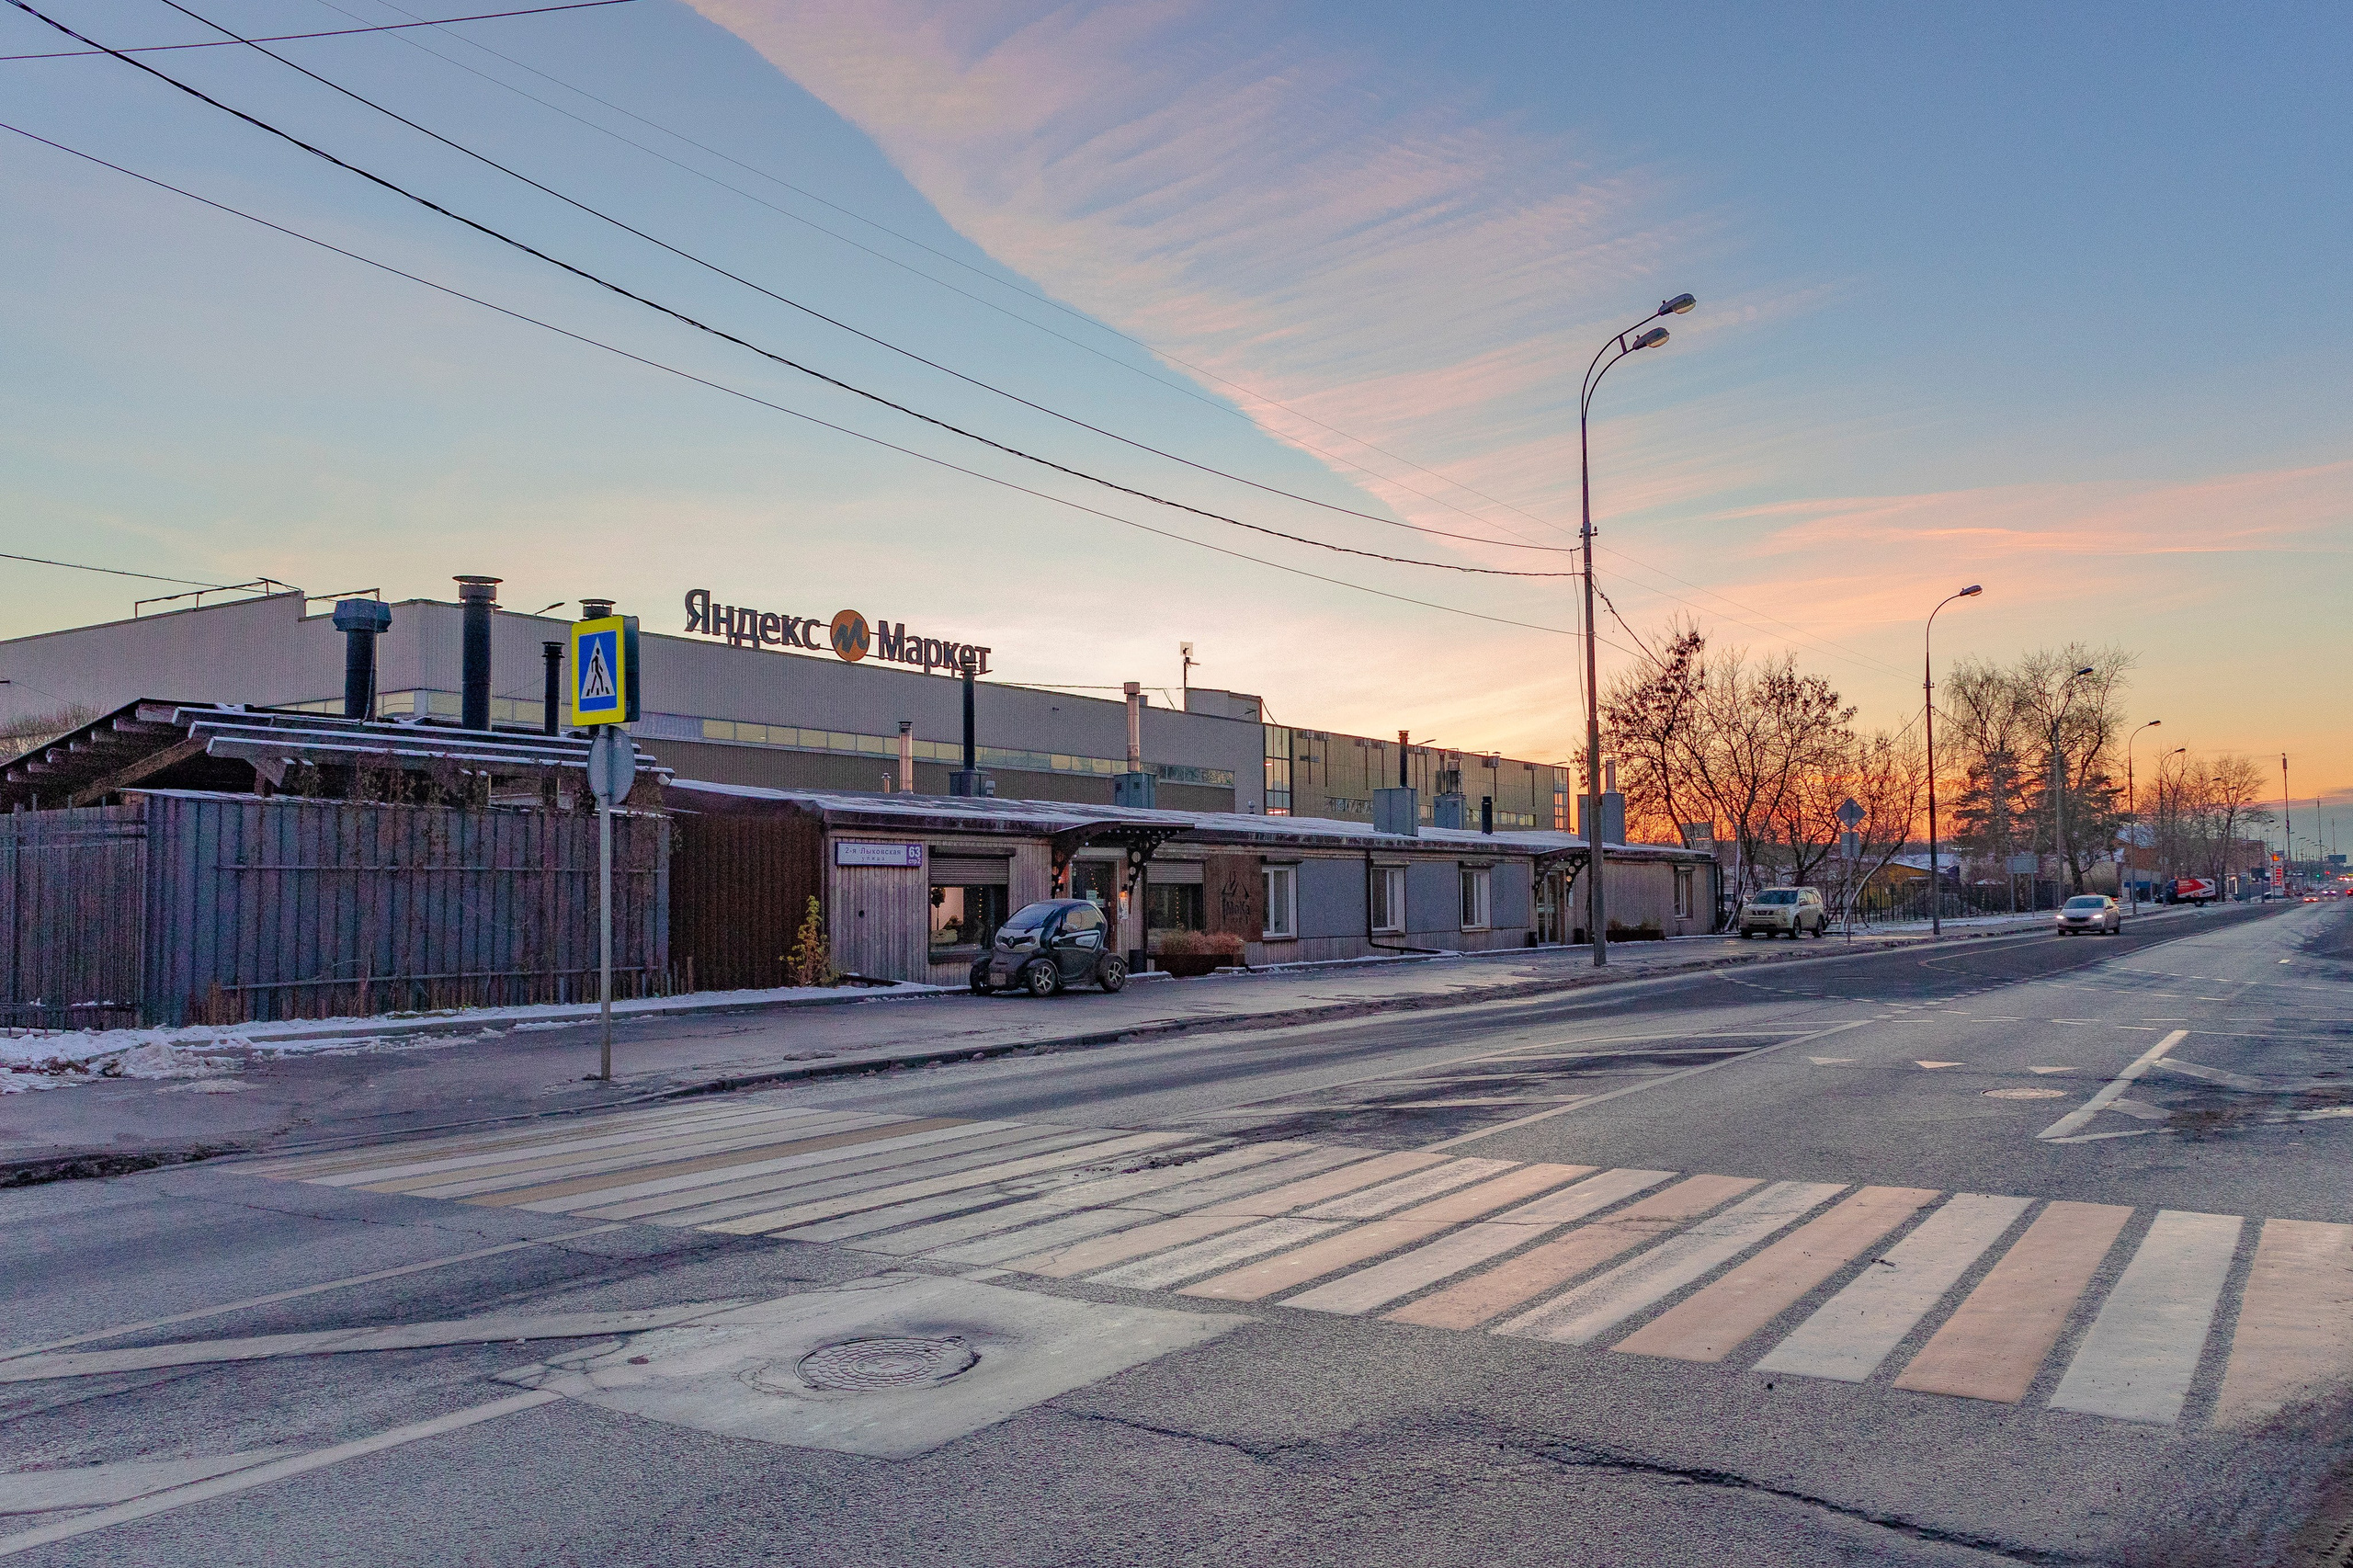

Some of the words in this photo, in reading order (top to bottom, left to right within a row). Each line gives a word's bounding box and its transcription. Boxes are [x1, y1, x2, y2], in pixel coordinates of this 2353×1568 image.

[684, 589, 821, 650] Яндекс
[879, 620, 992, 676] Маркет
[908, 846, 921, 858] 63
